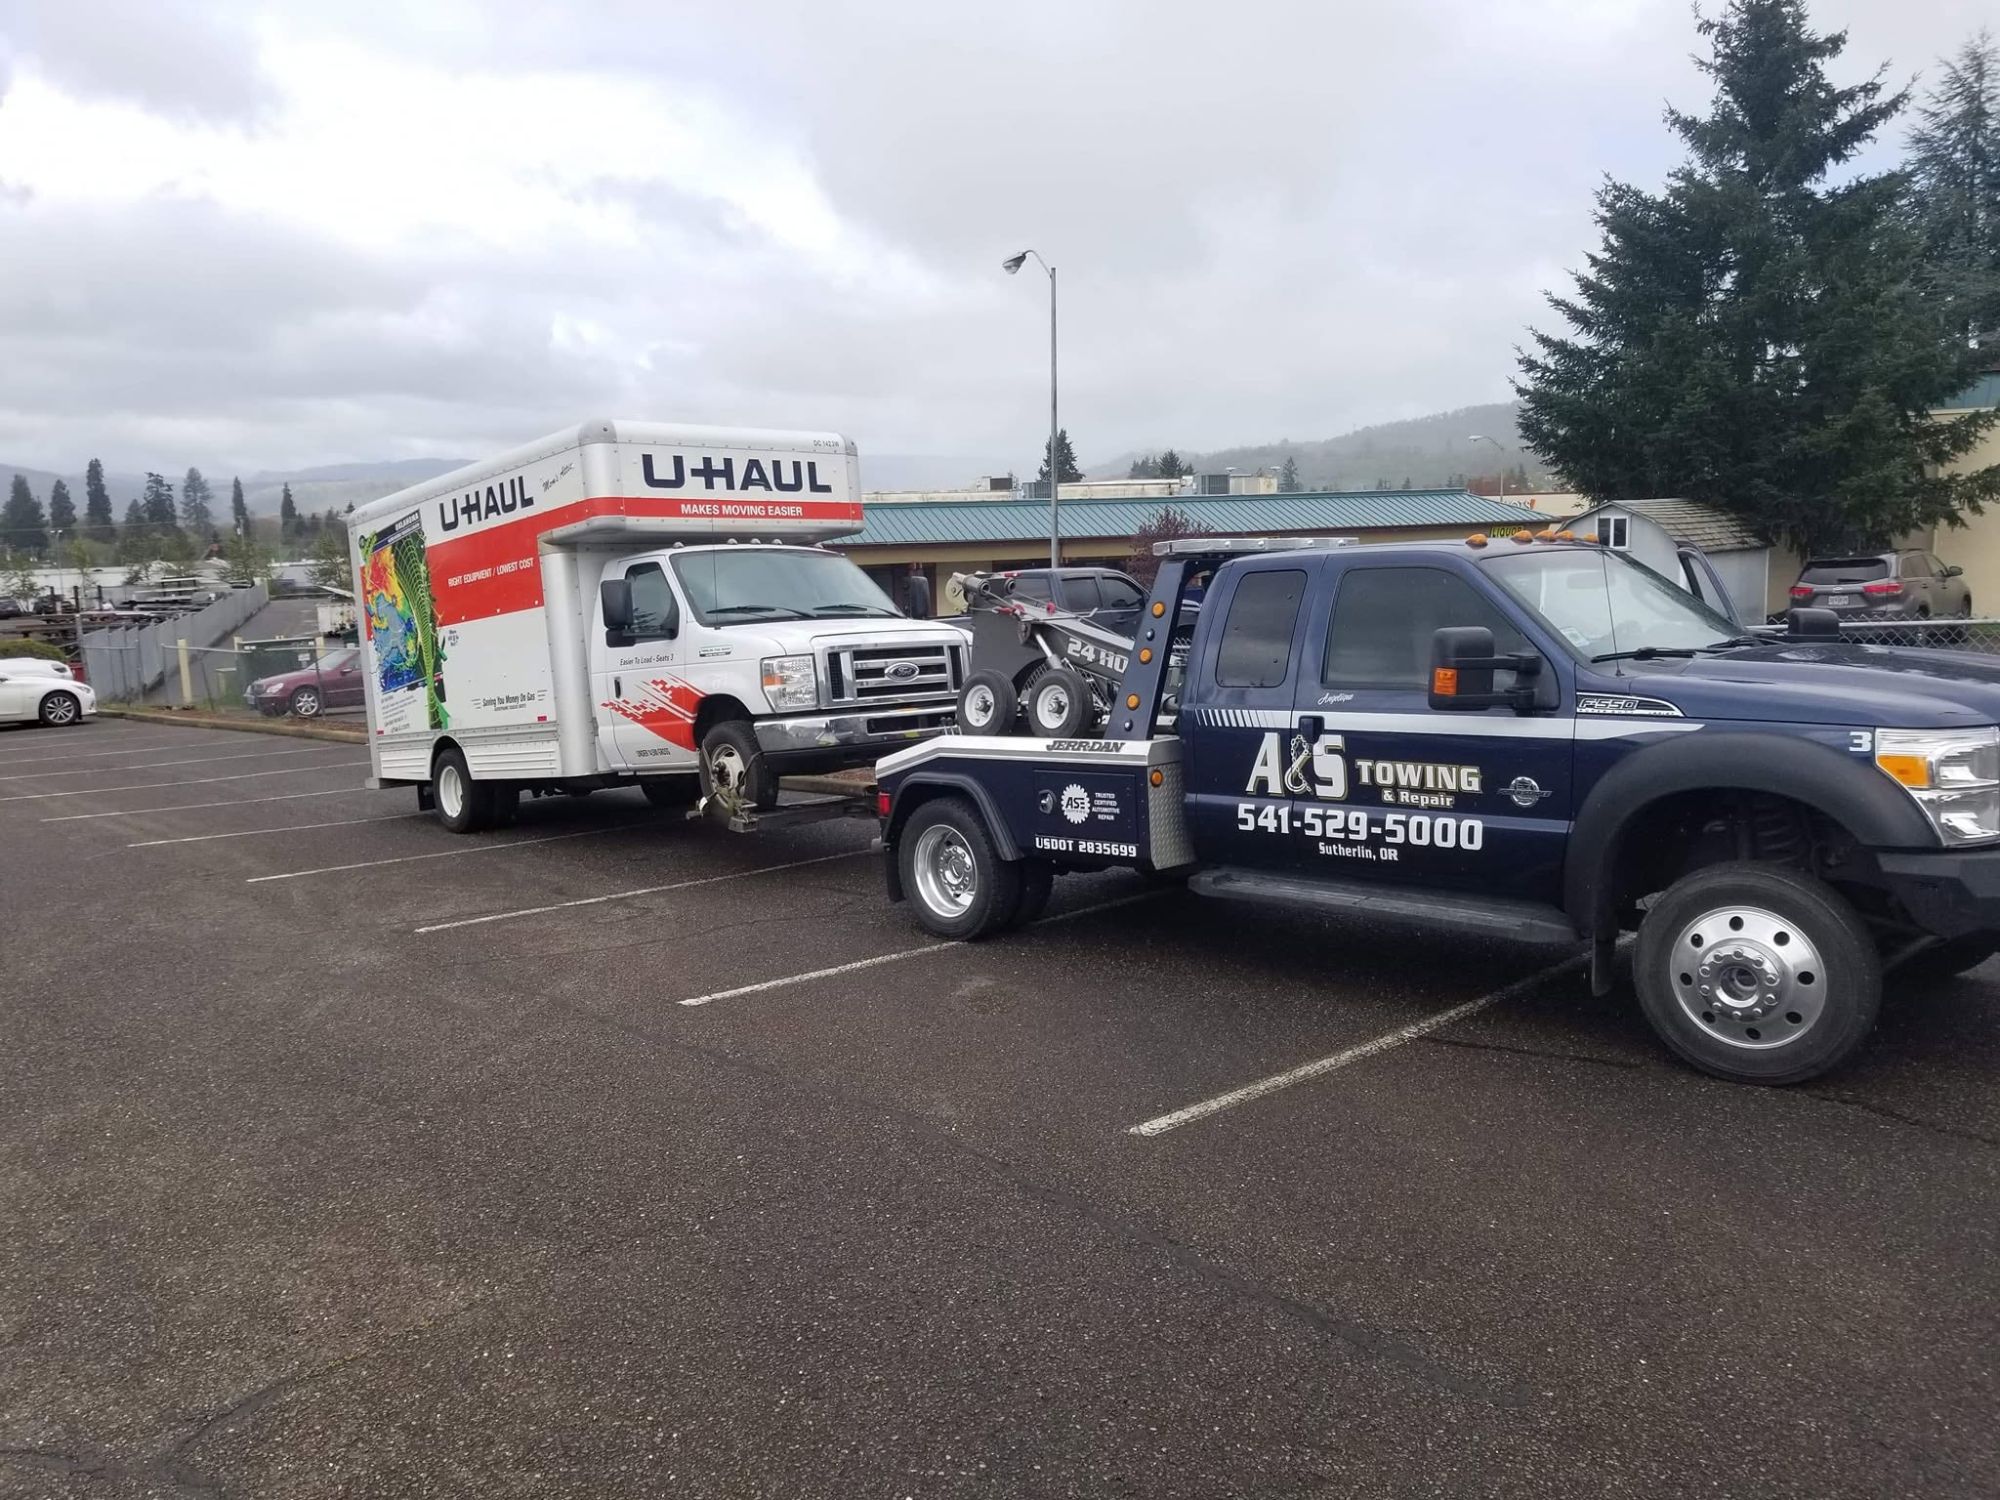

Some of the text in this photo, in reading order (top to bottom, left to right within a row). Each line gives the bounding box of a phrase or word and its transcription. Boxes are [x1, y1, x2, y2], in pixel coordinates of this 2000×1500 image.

[642, 453, 832, 493] U-HAUL
[439, 475, 534, 532] U-HAUL
[681, 504, 803, 516] MAKES MOVING EASIER
[463, 568, 492, 583] EQUIPMENT
[496, 561, 518, 576] LOWEST
[518, 557, 534, 570] COST
[656, 654, 669, 663] Seats
[1067, 637, 1096, 662] 24
[506, 695, 519, 704] Money
[527, 692, 535, 701] Gas
[1849, 731, 1872, 752] 3
[1355, 759, 1482, 793] TOWING
[1065, 797, 1085, 809] ASE
[1382, 789, 1454, 808] & Repair
[1092, 806, 1120, 814] AUTOMOTIVE
[1237, 803, 1483, 850] 541-529-5000
[1035, 837, 1137, 857] USDOT 2835699
[1319, 841, 1399, 861] Sutherlin, OR
